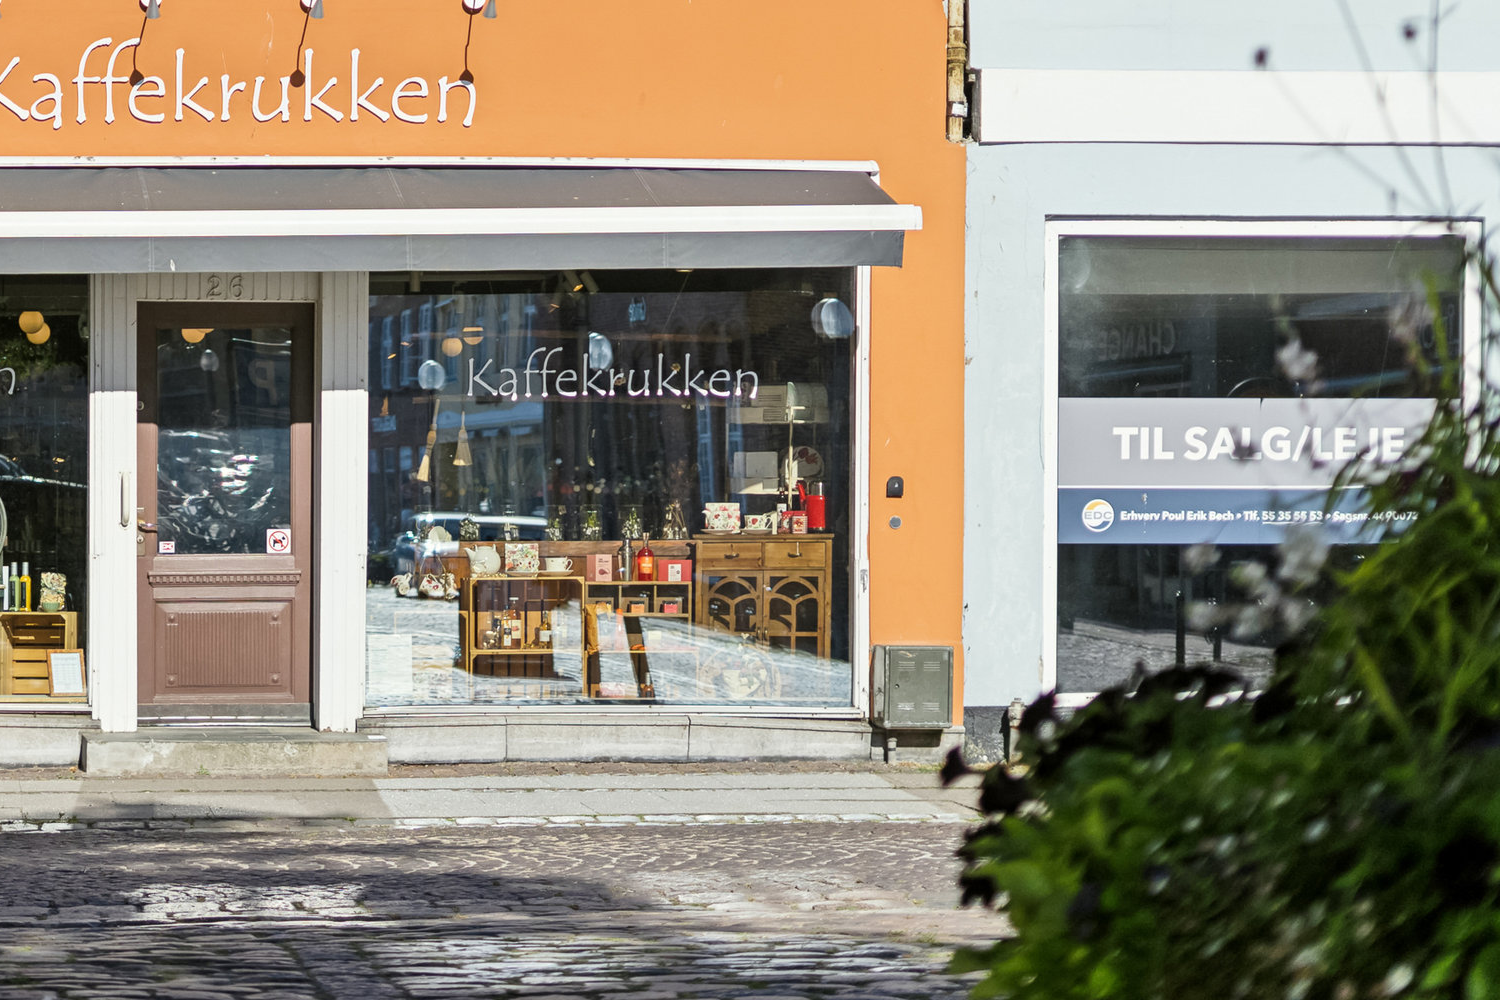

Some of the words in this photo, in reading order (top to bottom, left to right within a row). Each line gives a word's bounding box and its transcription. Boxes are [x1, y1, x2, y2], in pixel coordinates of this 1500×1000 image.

[467, 347, 759, 401] Kaffekrukken
[1112, 426, 1175, 460] TIL
[1084, 511, 1113, 520] EDC
[1120, 510, 1160, 521] Erhverv
[1162, 510, 1185, 521] Poul
[1187, 510, 1208, 521] Erik
[1209, 510, 1235, 521] Bech
[1262, 510, 1276, 521] 55
[1278, 510, 1292, 521] 35
